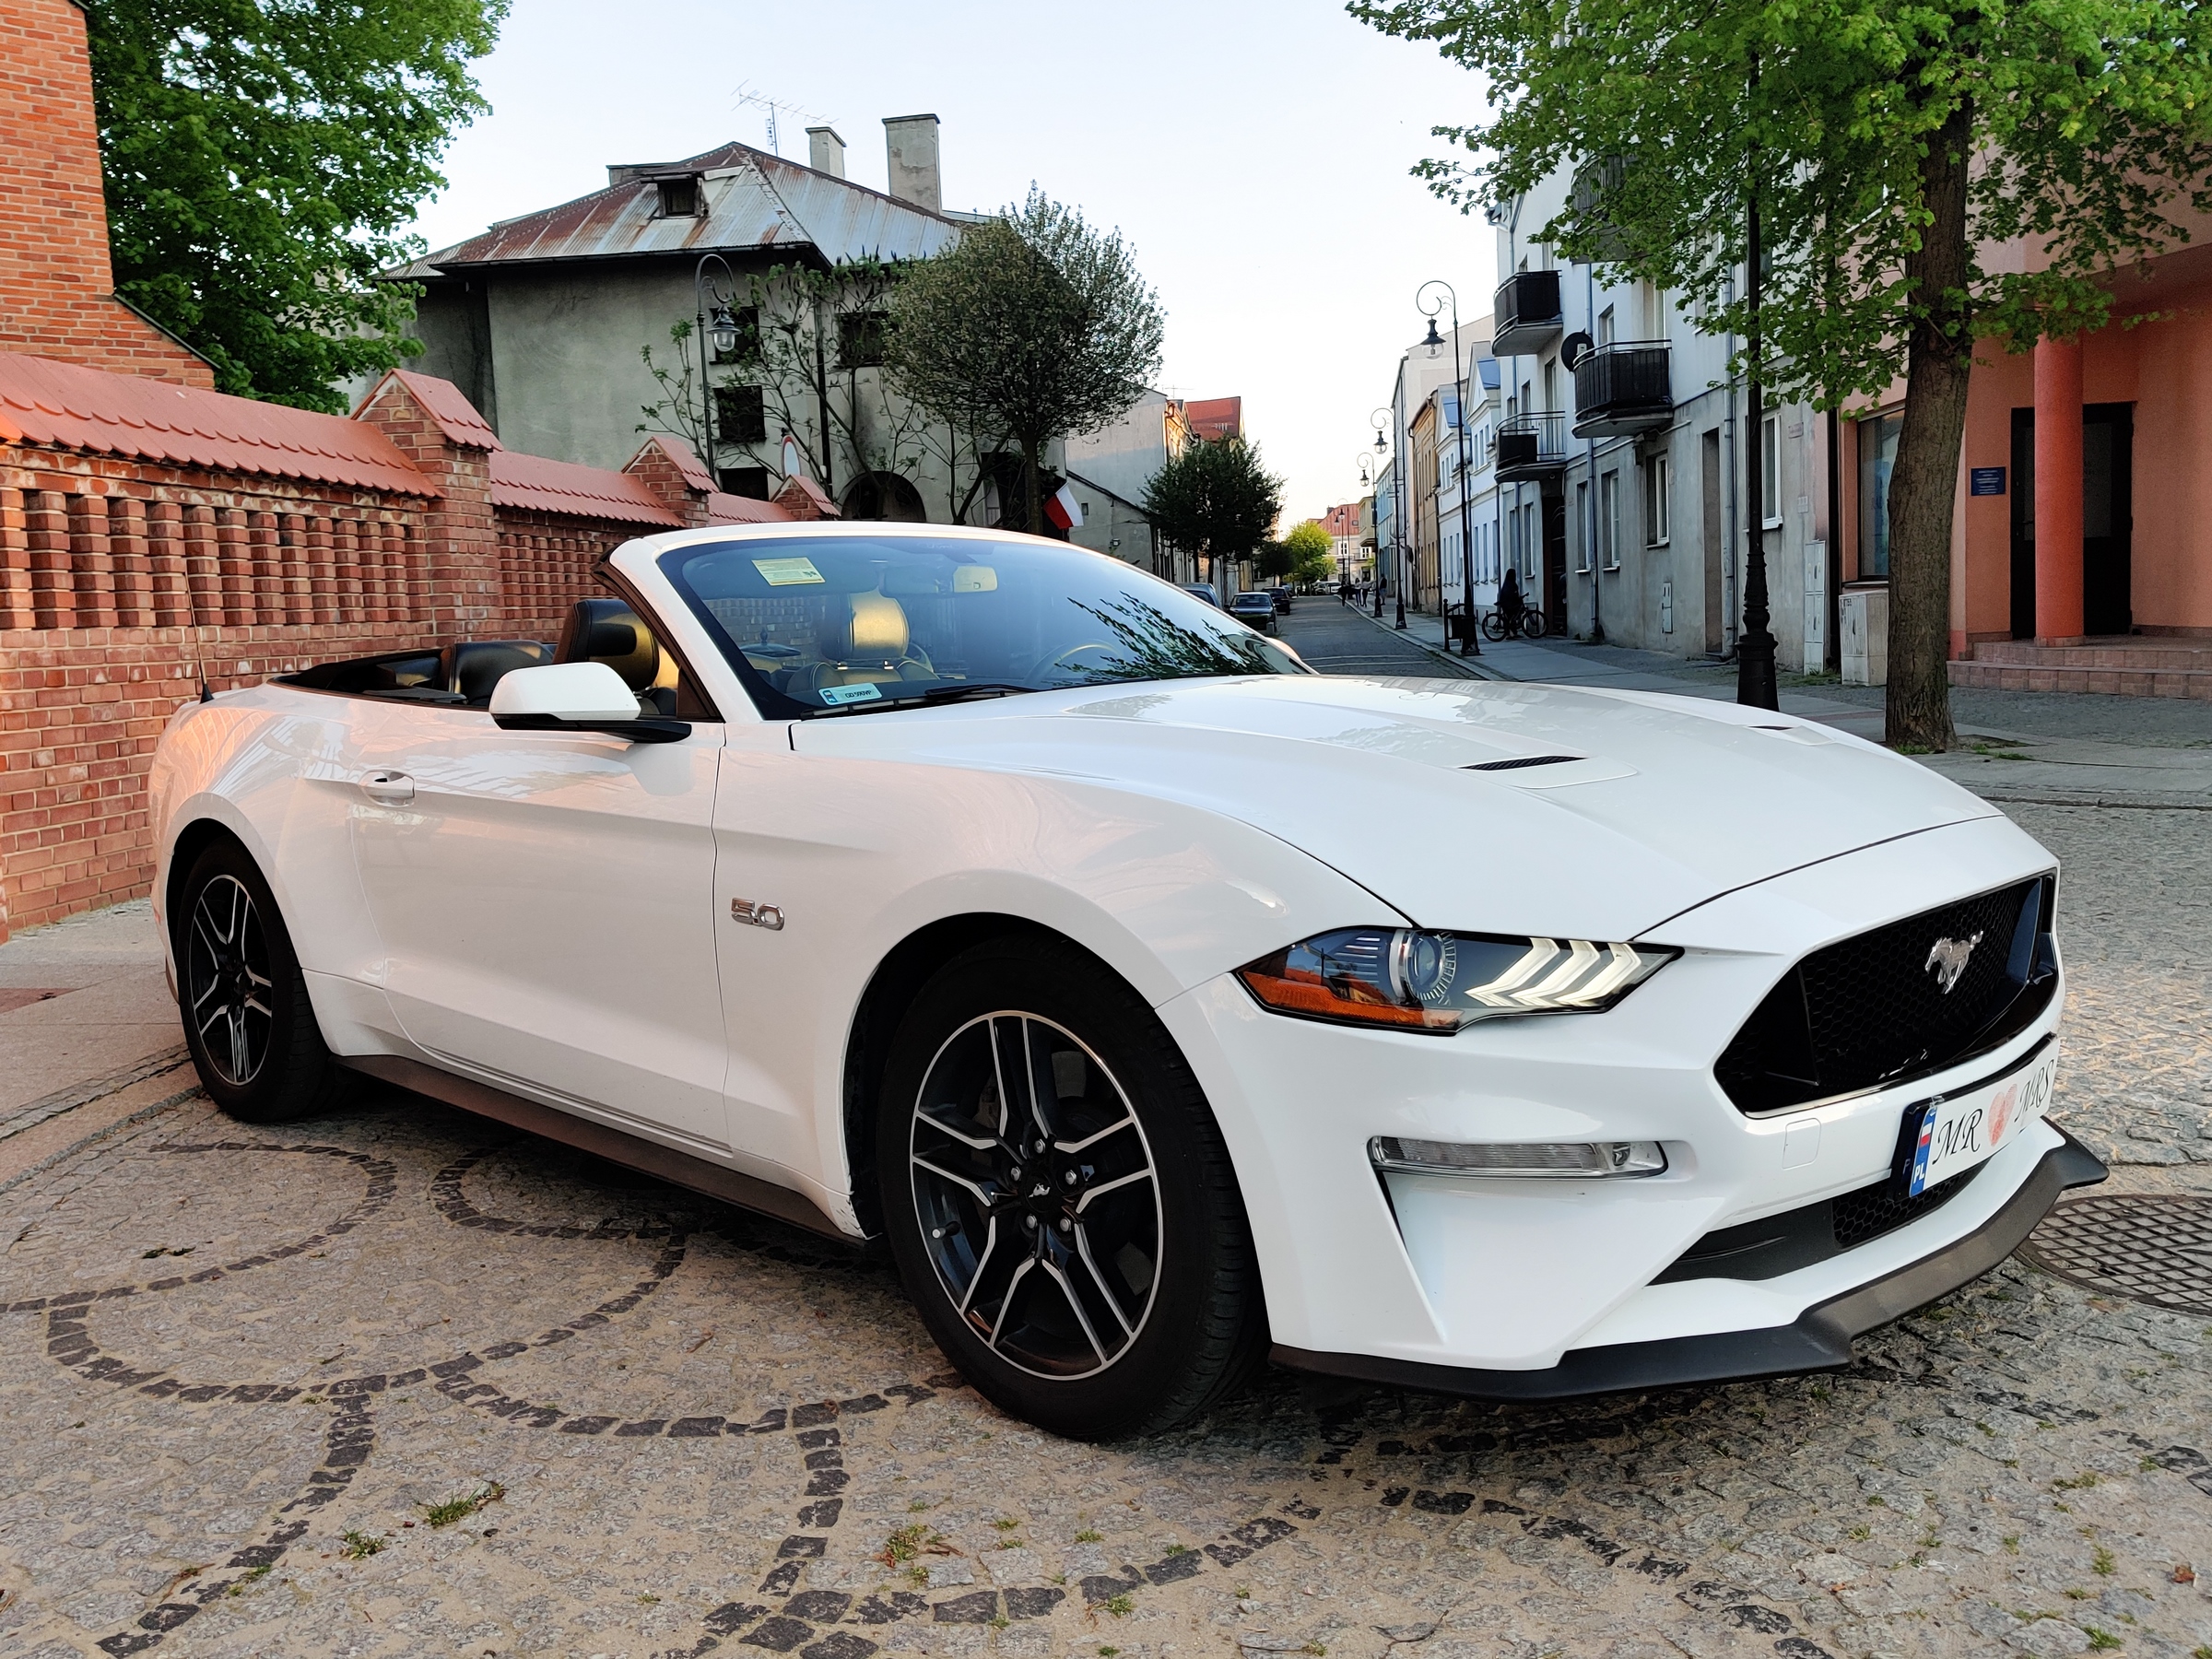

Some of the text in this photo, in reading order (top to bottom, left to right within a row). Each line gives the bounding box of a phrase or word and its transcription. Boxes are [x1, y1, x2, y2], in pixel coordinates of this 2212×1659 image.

[731, 897, 785, 932] 5.0
[1932, 1058, 2055, 1165] MR MRS
[1912, 1164, 1925, 1184] PL
